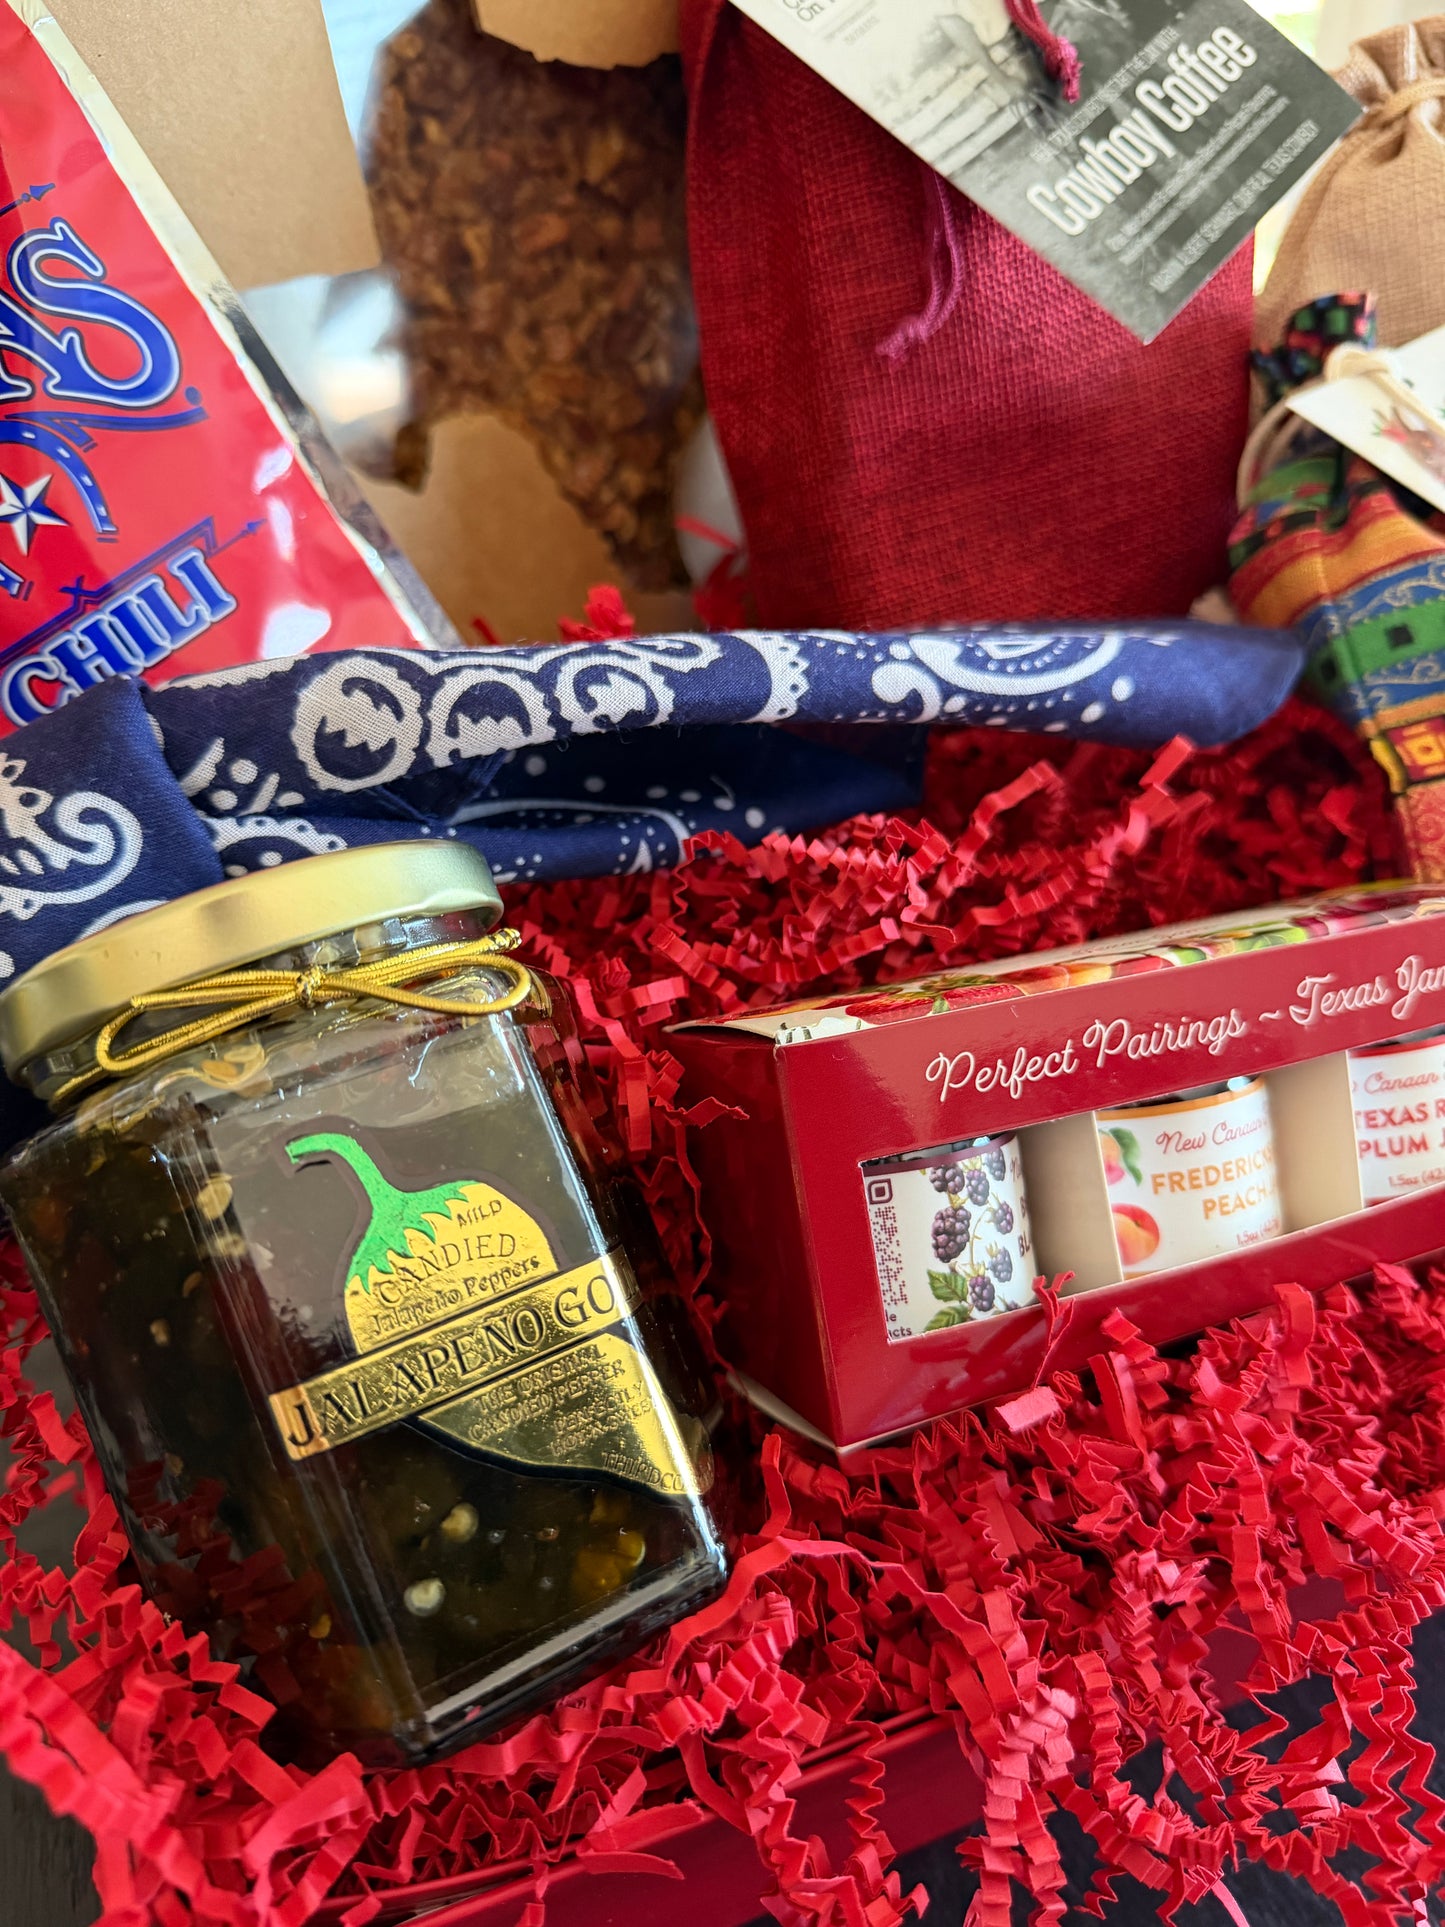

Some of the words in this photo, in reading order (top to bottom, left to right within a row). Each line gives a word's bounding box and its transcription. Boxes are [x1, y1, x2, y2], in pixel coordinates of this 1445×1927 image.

[1026, 107, 1176, 236] Cowboy
[1135, 26, 1258, 132] Coffee
[2, 547, 237, 727] CHILI
[925, 1039, 1080, 1102] Perfect
[1082, 1008, 1247, 1068] Pairings
[1289, 972, 1390, 1028] Texas
[1364, 1071, 1438, 1095] Canaan
[1155, 1130, 1206, 1155] New
[1358, 1133, 1428, 1159] PLUM
[456, 1200, 502, 1228] MILD
[378, 1232, 517, 1305] CANDIED
[463, 1255, 540, 1298] Peppers
[468, 1393, 553, 1443] CANDIED
[551, 1358, 627, 1406] PEPPER
[475, 1383, 518, 1415] THE
[553, 1380, 643, 1435] PERFECTLY
